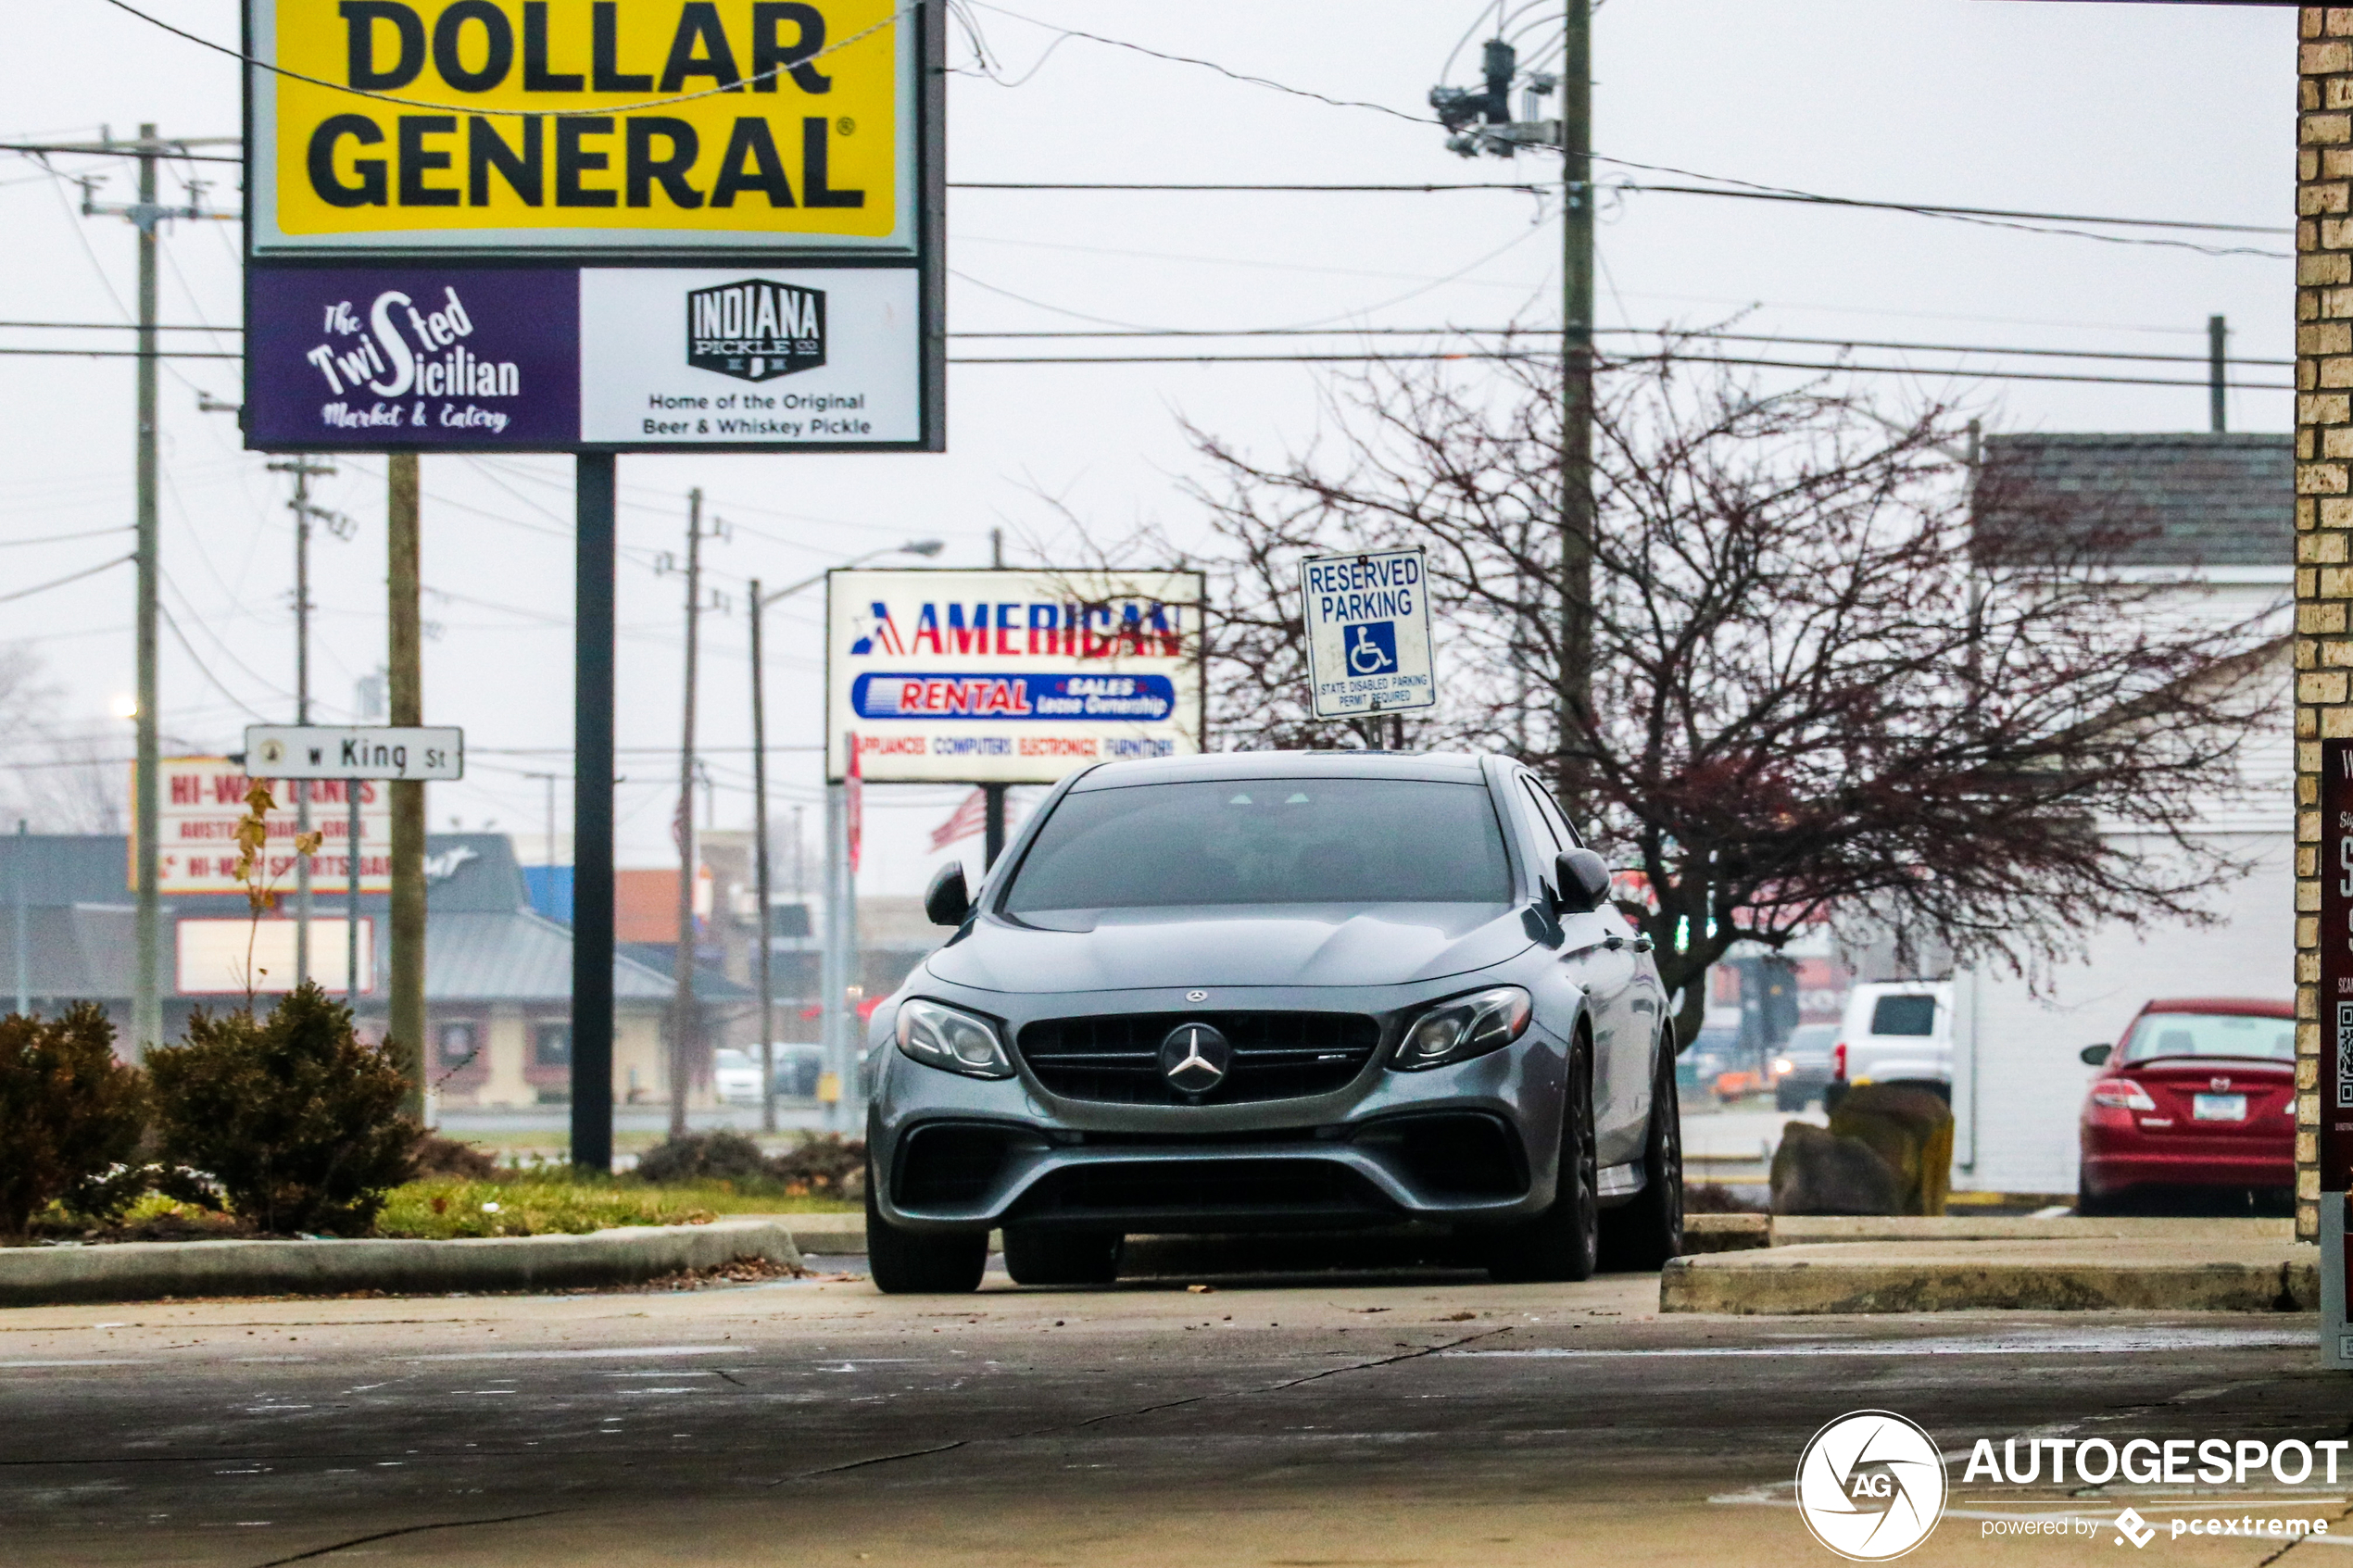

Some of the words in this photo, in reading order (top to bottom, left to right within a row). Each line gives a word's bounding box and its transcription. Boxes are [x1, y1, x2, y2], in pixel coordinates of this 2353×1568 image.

[340, 0, 831, 94] DOLLAR
[308, 114, 865, 209] GENERAL
[324, 301, 362, 335] The
[694, 284, 819, 340] INDIANA
[696, 340, 790, 356] PICKLE
[321, 402, 405, 428] Market
[411, 401, 427, 426] &
[440, 403, 510, 434] Eatery
[649, 394, 708, 409] Home
[716, 394, 736, 409] of
[743, 394, 776, 409] the
[784, 394, 864, 412] Original
[643, 419, 689, 434] Beer
[697, 419, 709, 434] &
[717, 419, 802, 436] Whiskey
[811, 419, 871, 434] Pickle
[1310, 558, 1418, 594] RESERVED
[1322, 589, 1412, 622] PARKING
[912, 601, 1180, 657] AMERICAN
[899, 679, 1032, 713] RENTAL
[1067, 677, 1135, 696] SALES
[1321, 683, 1346, 695] STATE
[1350, 678, 1388, 692] DISABLED
[1392, 674, 1428, 687] PARKING
[1340, 694, 1366, 707] PERMIT
[1372, 691, 1411, 704] REQUIRED
[341, 739, 406, 778] King
[426, 748, 445, 768] St
[934, 736, 1013, 756] COMPUTERS
